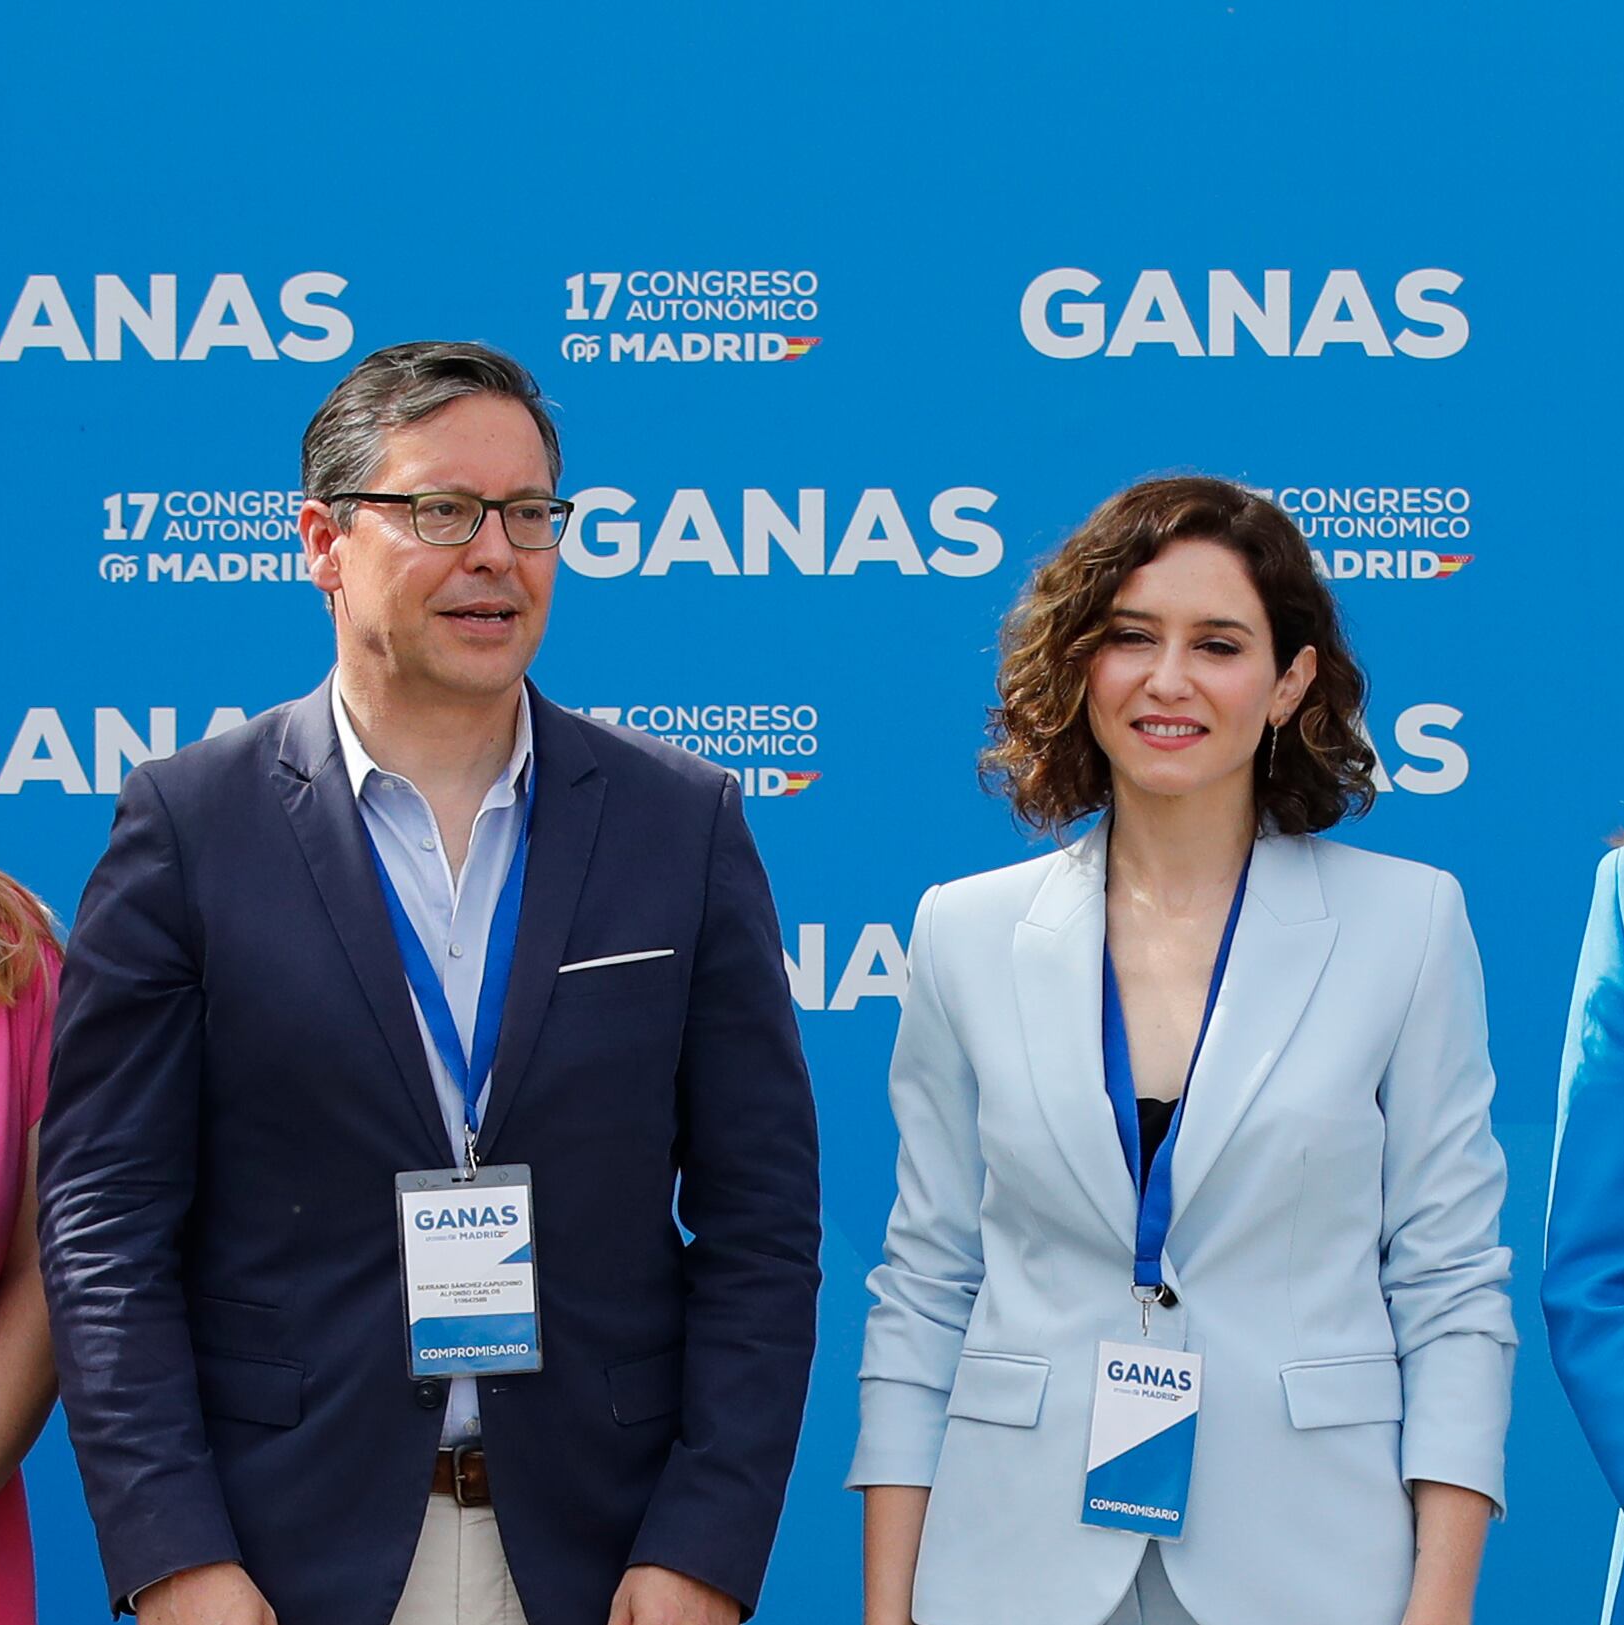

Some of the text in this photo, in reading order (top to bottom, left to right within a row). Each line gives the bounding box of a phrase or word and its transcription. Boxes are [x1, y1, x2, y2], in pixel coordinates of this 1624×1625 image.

[566, 271, 817, 320] 17 CONGRESO
[628, 296, 817, 320] AUTONÓMICO
[1021, 268, 1469, 358] GANAS
[610, 333, 787, 361] MADRID
[1279, 488, 1470, 513] CONGRESO
[104, 493, 159, 540] 17
[560, 487, 1003, 578] GANAS
[626, 705, 817, 731] CONGRESO
[415, 1205, 519, 1230] GANAS
[460, 1230, 500, 1240] MADRID
[420, 1343, 529, 1359] COMPROMISARIO
[1107, 1360, 1192, 1392] GANAS
[1142, 1388, 1176, 1401] MADRID
[1090, 1498, 1179, 1521] COMPROMISARIO
